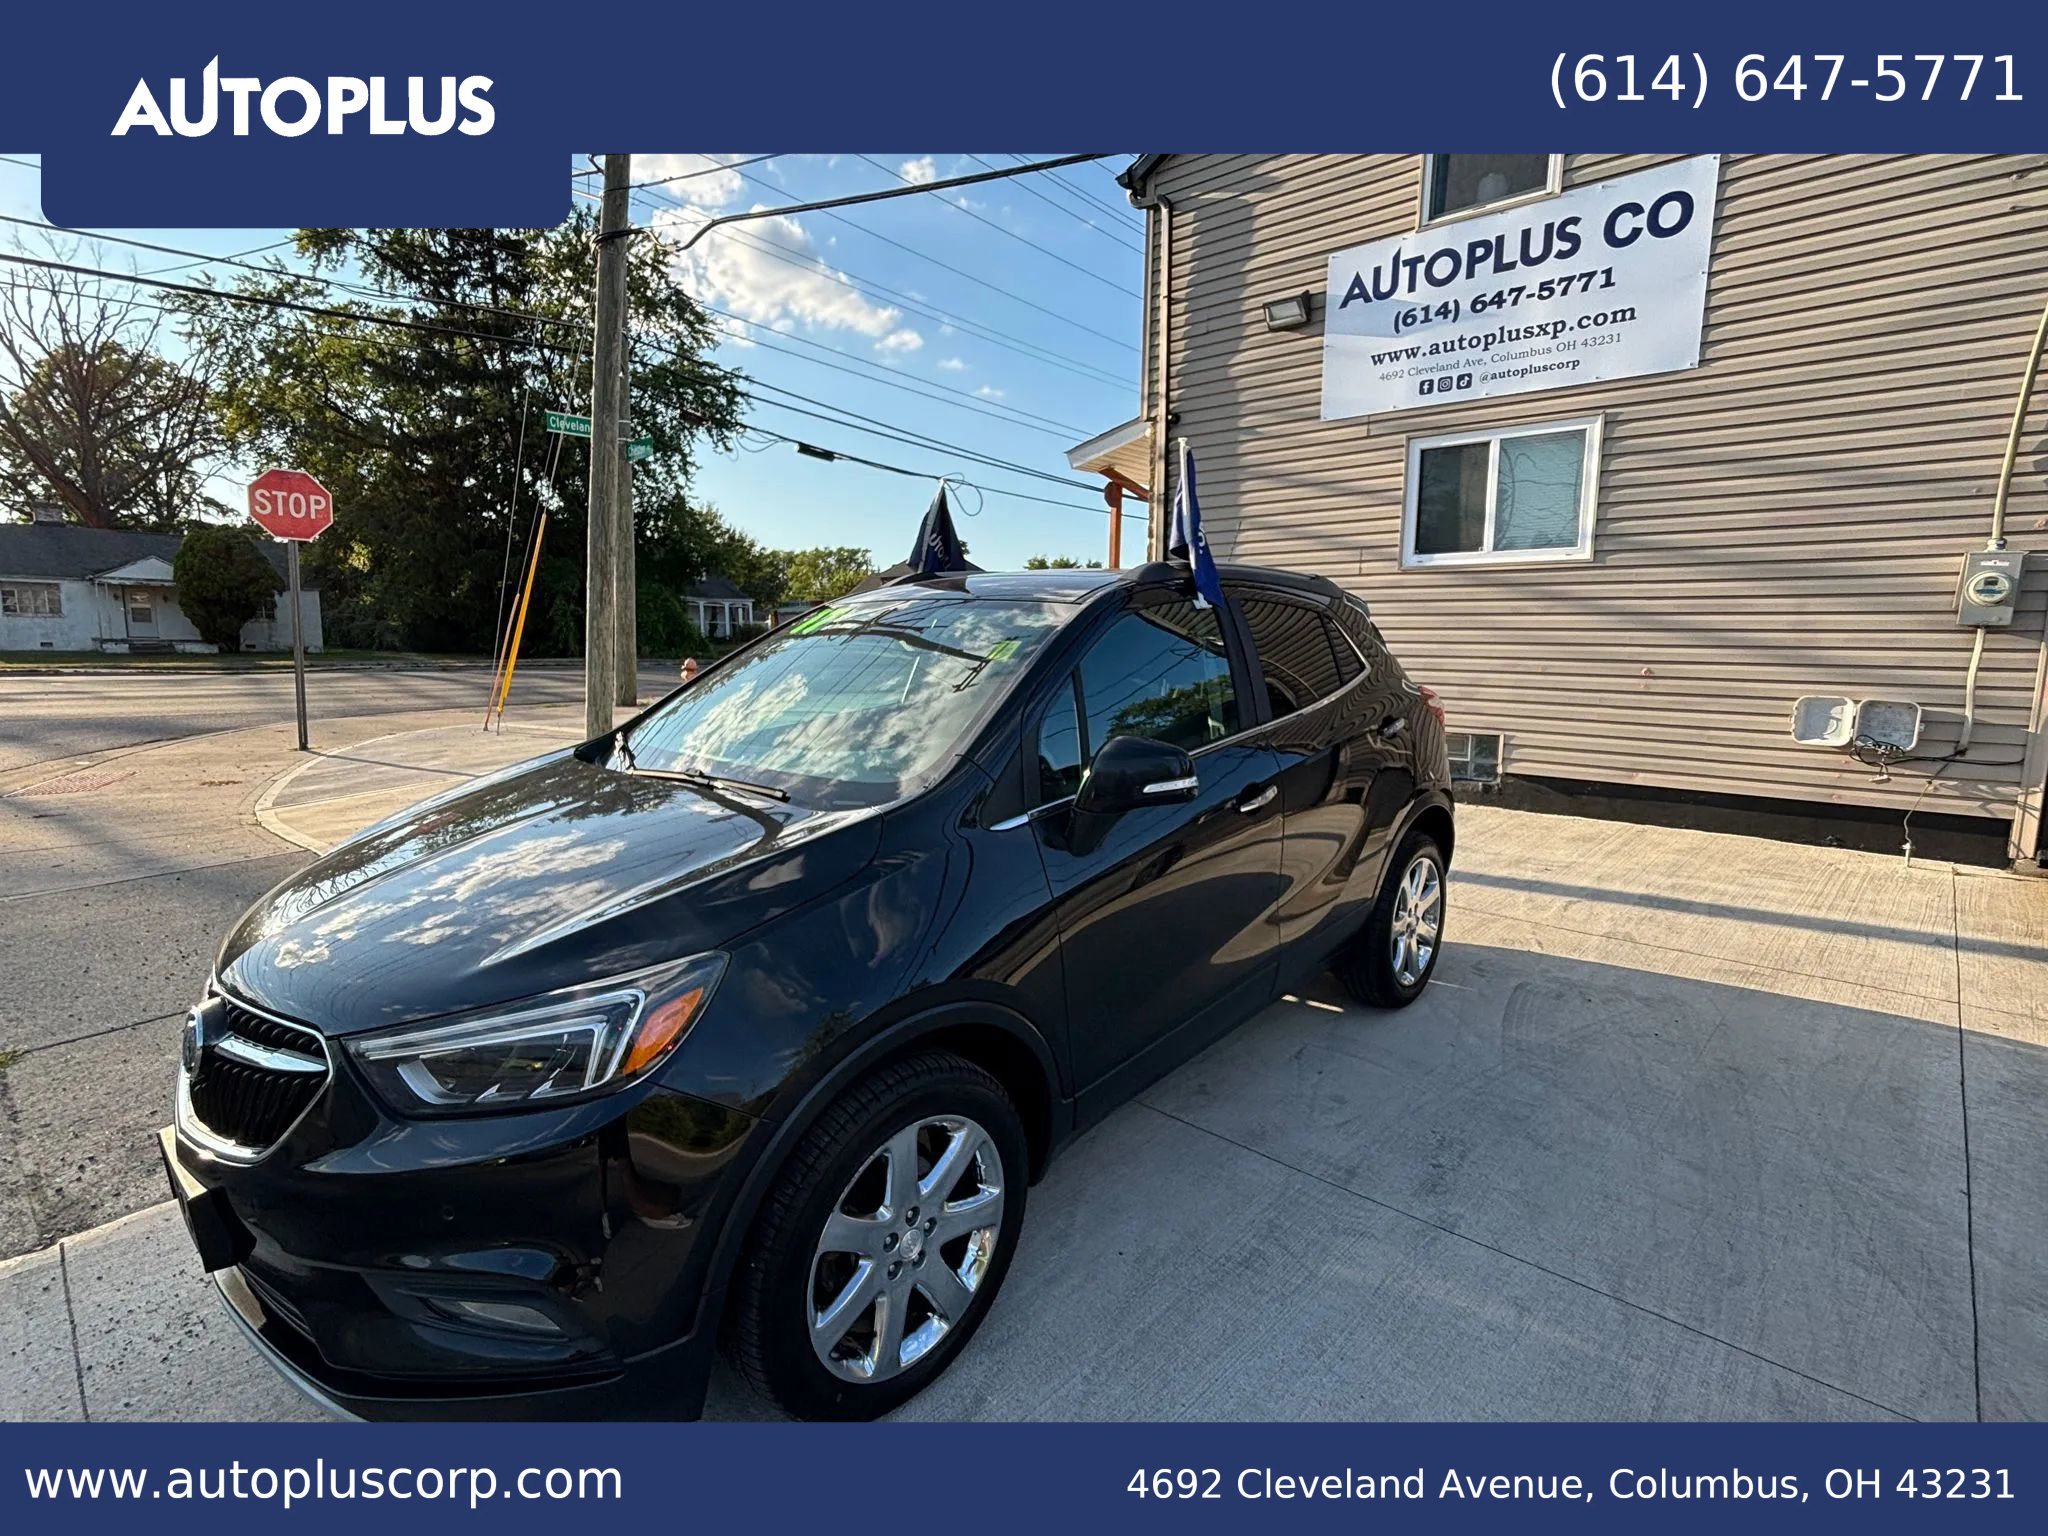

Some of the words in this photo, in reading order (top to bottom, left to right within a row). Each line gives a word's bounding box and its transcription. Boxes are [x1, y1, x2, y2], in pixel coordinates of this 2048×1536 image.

[1338, 215, 1583, 310] AUTOPLUS
[1603, 190, 1695, 249] CO
[1394, 297, 1460, 334] (614)
[1470, 266, 1617, 314] 647-5771
[1371, 305, 1637, 367] www.autoplusxp.com
[1379, 368, 1405, 382] 4692
[1407, 359, 1460, 378] Cleveland
[1463, 356, 1487, 370] Ave,
[1490, 343, 1552, 365] Columbus
[1556, 339, 1577, 353] OH
[1580, 332, 1622, 348] 43231
[1479, 357, 1581, 384] @autopluscorp
[549, 416, 591, 433] Clevelan
[254, 488, 327, 520] STOP
